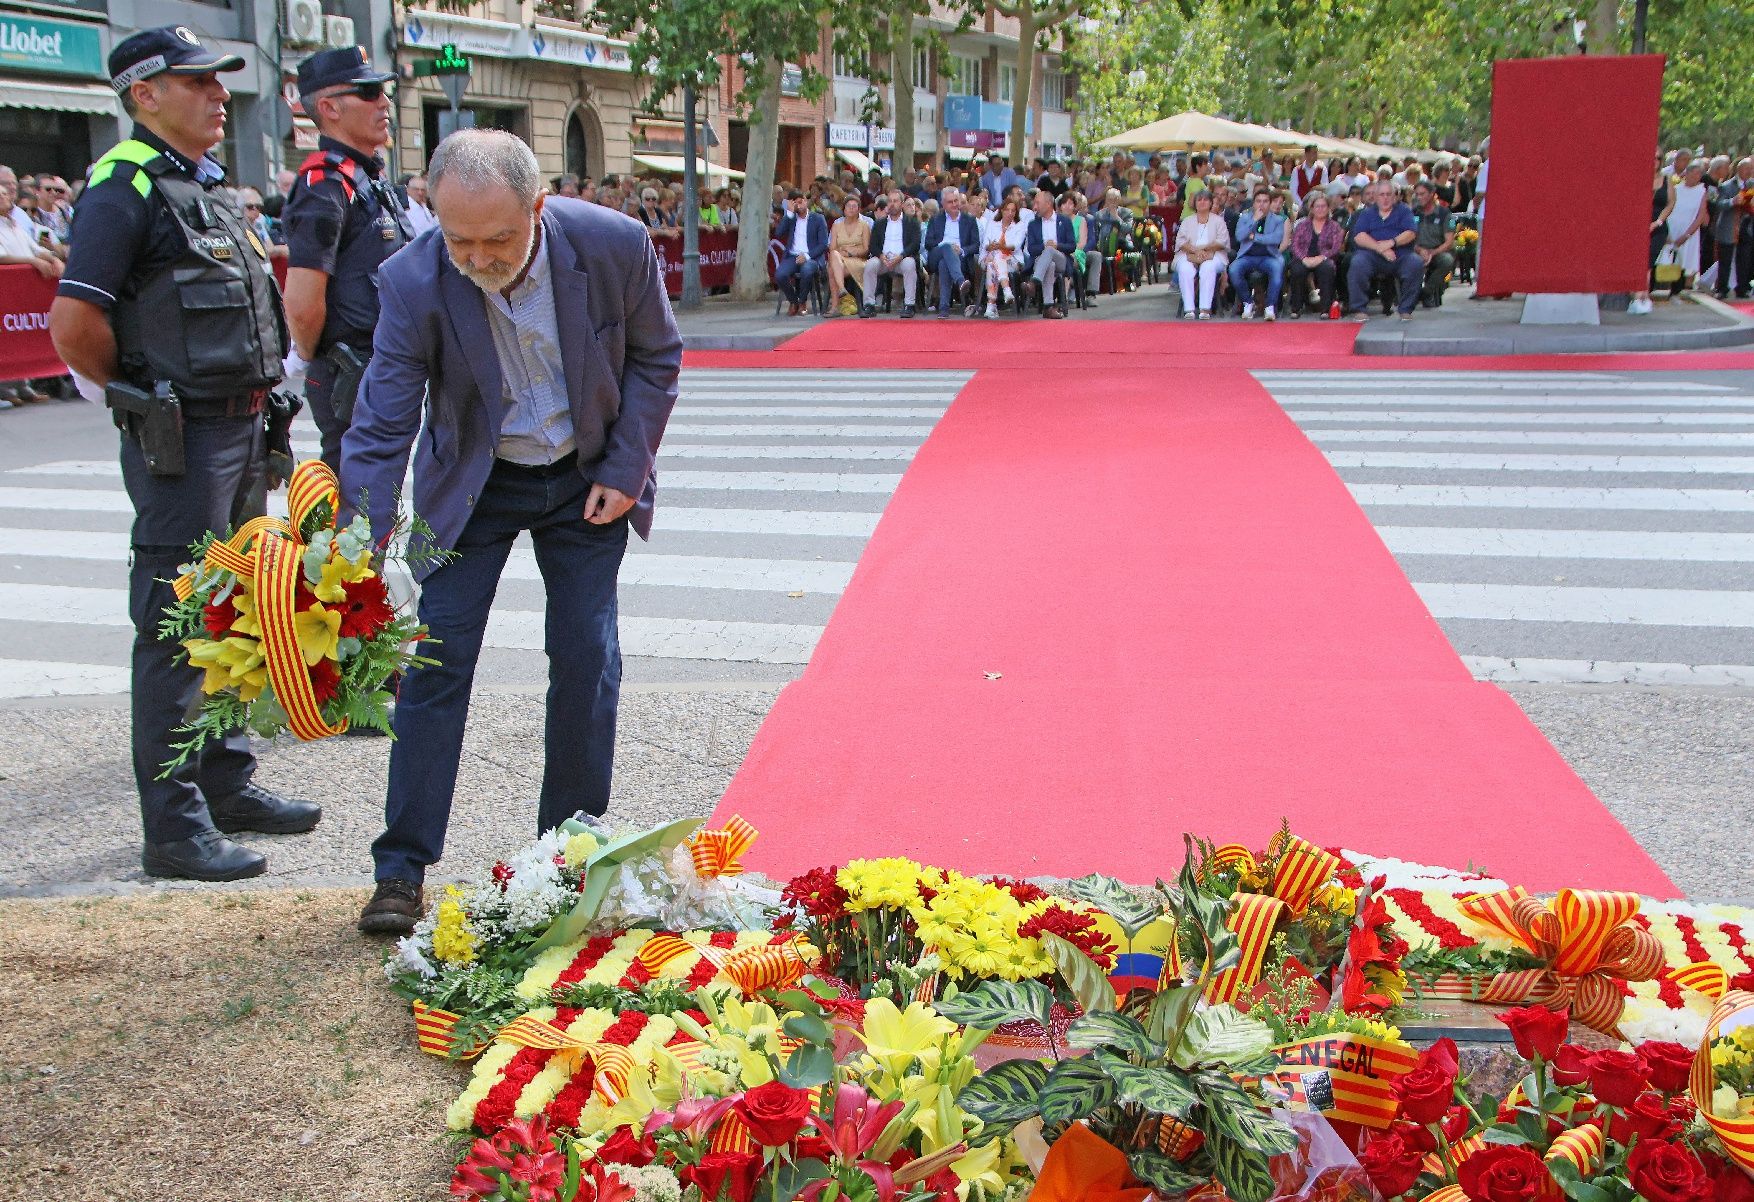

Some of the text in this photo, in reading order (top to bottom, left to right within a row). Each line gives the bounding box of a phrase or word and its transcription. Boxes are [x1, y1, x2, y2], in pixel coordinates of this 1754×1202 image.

[0, 22, 62, 56] Llobet
[3, 311, 51, 332] CULTU
[1271, 1038, 1379, 1080] ENEGAL
